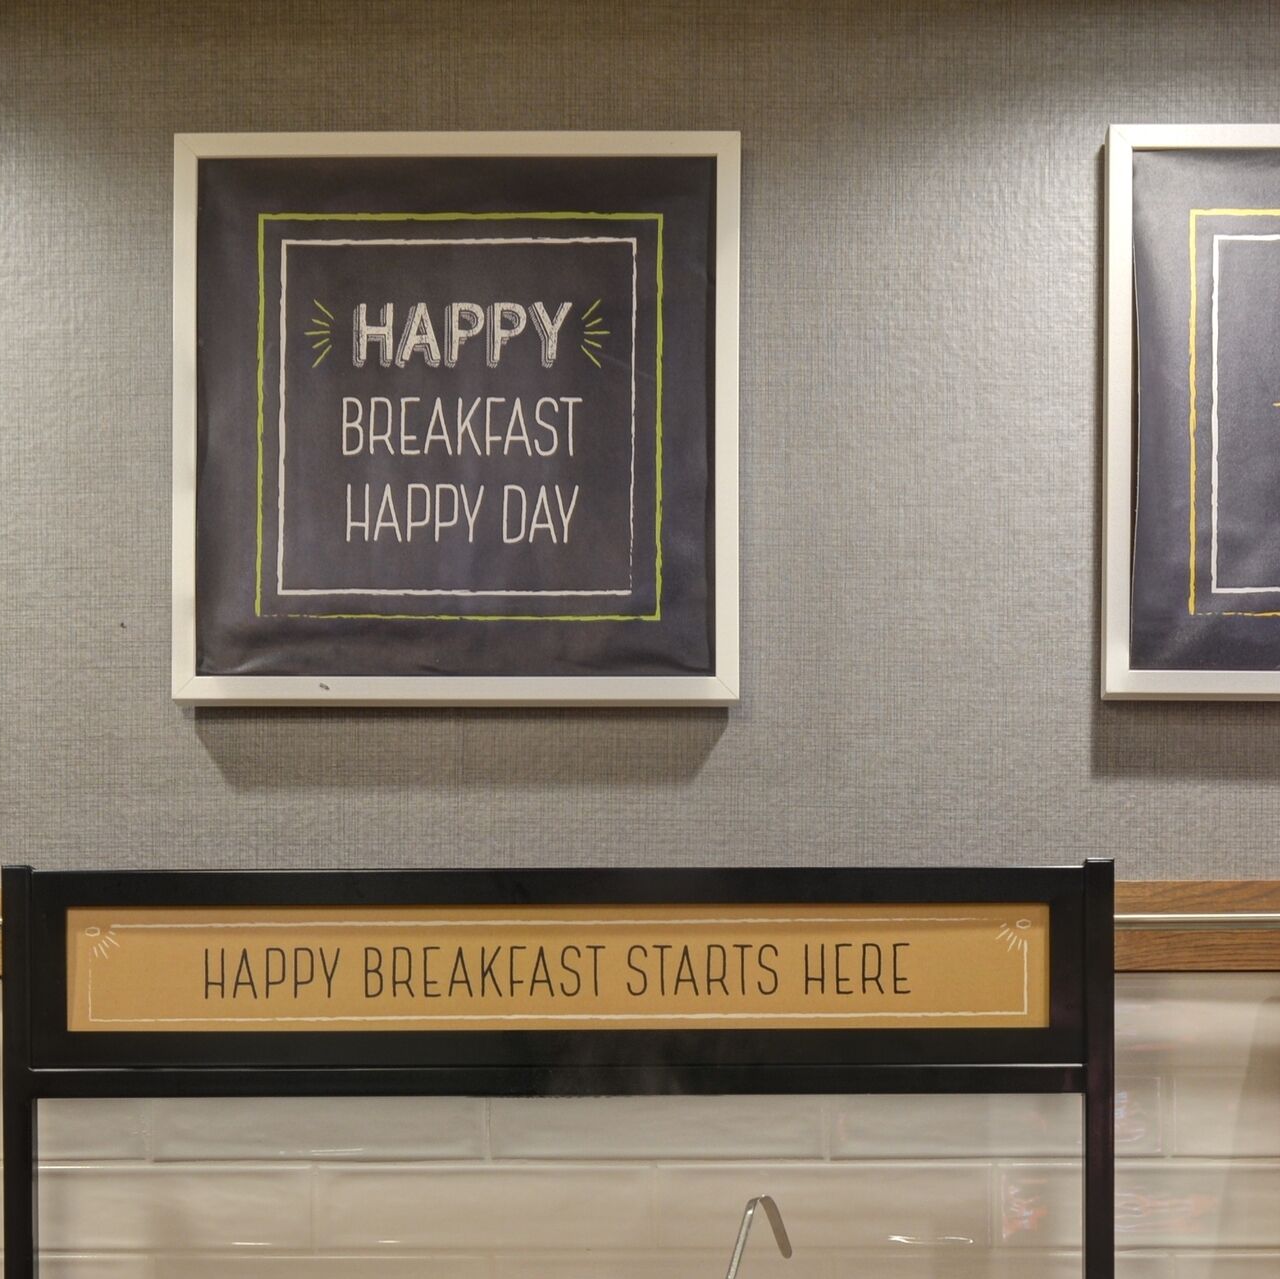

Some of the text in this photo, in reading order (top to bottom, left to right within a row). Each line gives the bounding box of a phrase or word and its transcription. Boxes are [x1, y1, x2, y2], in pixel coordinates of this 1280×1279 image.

[352, 301, 573, 368] HAPPY
[341, 397, 583, 457] BREAKFAST
[345, 483, 579, 544] HAPPY DAY
[205, 943, 911, 999] HAPPY BREAKFAST STARTS HERE
